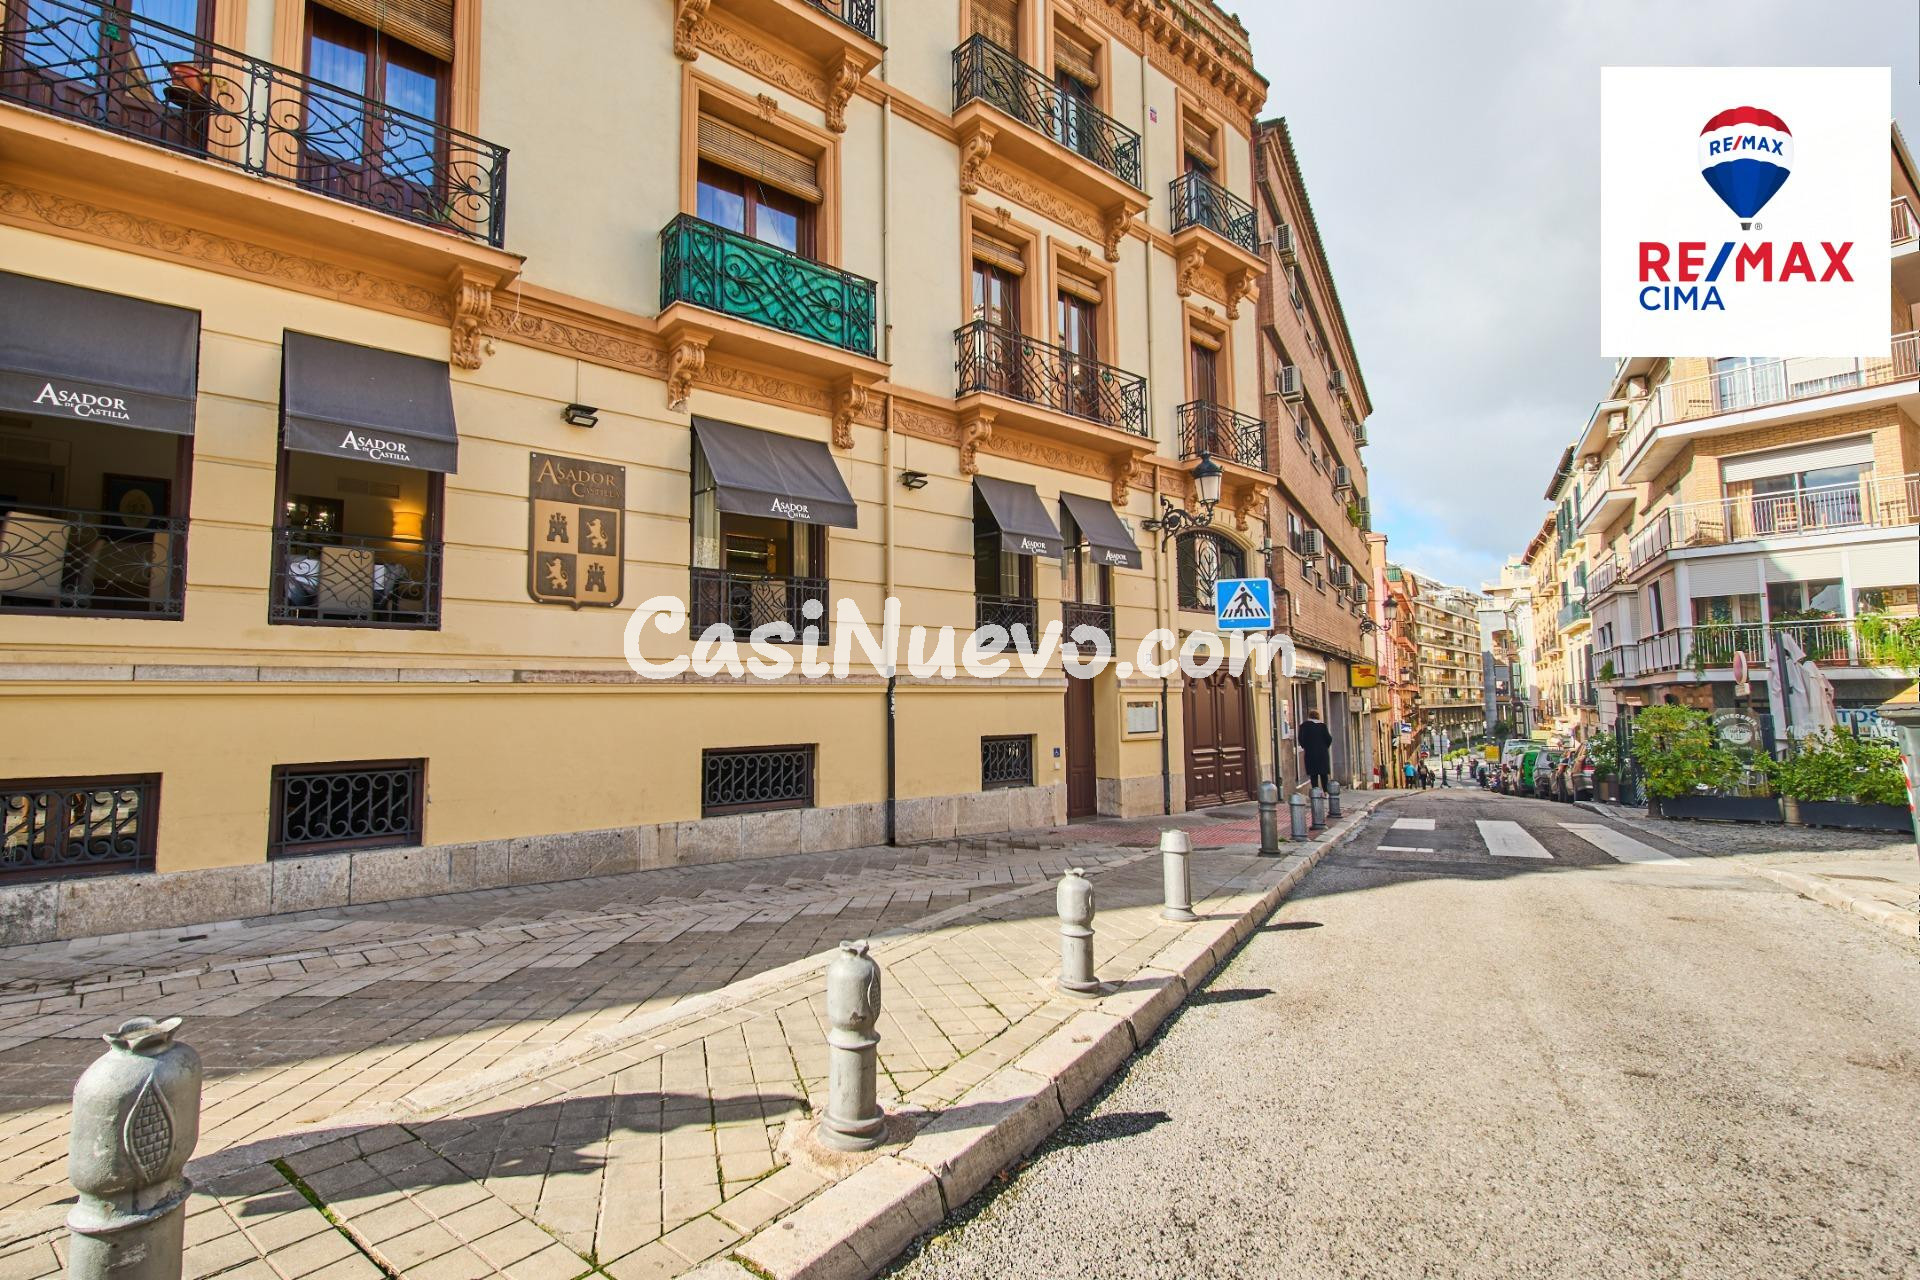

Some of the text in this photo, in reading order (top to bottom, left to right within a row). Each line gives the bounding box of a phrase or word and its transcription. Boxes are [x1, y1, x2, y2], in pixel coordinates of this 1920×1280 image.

[33, 382, 128, 411] ASADOR
[74, 404, 130, 420] CASTILLA
[338, 430, 408, 453] ASADOR
[369, 448, 411, 461] CASTILLA
[536, 458, 617, 487] ASADOR
[770, 497, 809, 513] ASADOR
[1020, 536, 1046, 549] ASADOR
